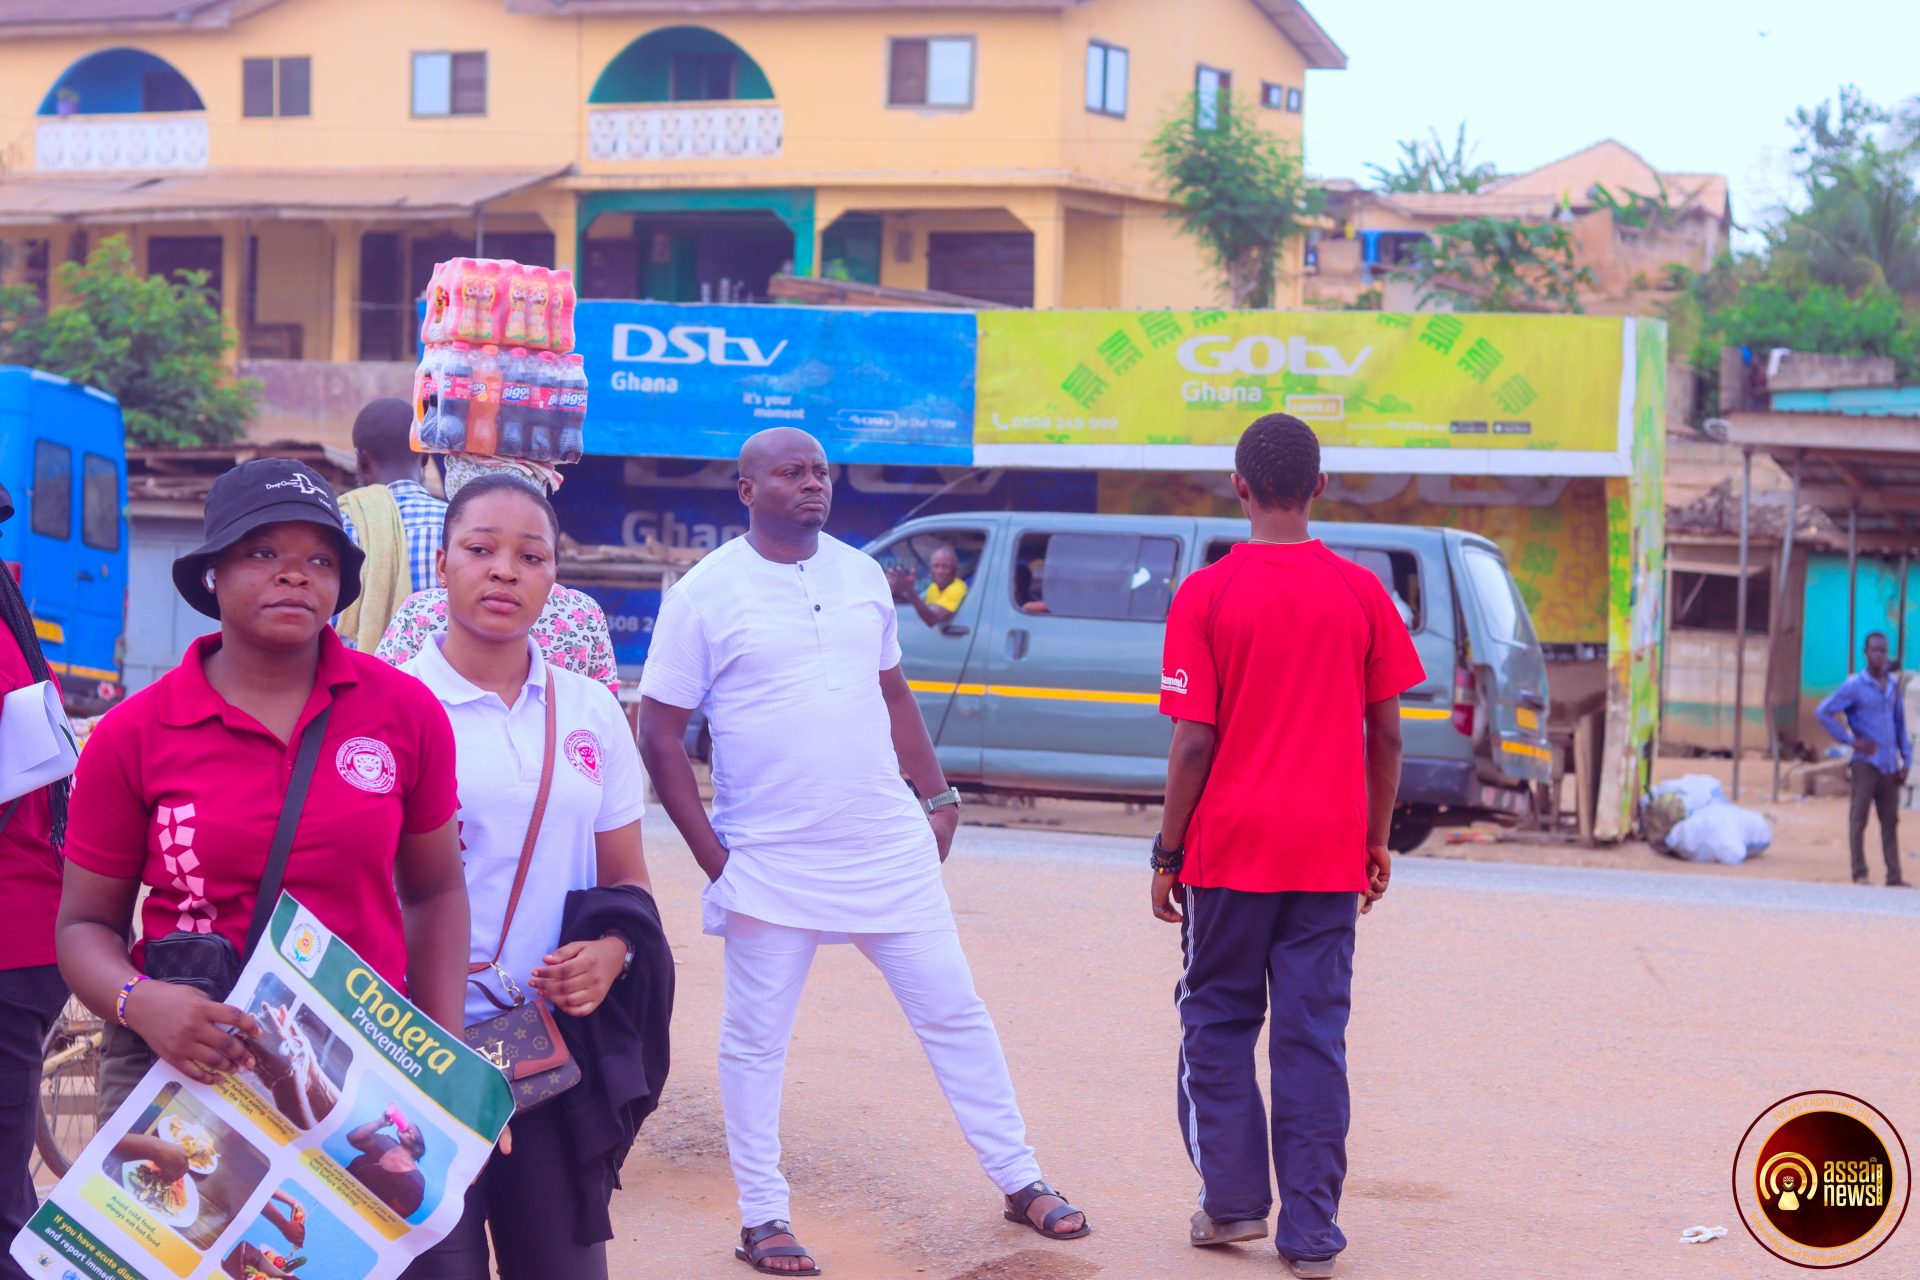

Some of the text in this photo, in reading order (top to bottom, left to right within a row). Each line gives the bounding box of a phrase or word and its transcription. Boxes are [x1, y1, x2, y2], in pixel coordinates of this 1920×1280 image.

[612, 323, 788, 367] DStv
[1176, 335, 1373, 376] GOtv
[611, 371, 679, 393] Ghana
[1182, 381, 1262, 403] Ghana
[754, 407, 805, 419] moment
[345, 967, 457, 1075] Cholera
[352, 1006, 423, 1078] Prevention
[44, 1226, 60, 1241] and
[59, 1238, 87, 1262] report
[53, 1214, 62, 1223] If
[60, 1221, 76, 1237] you
[76, 1232, 96, 1252] have
[95, 1250, 118, 1269] acute
[125, 1218, 135, 1228] eat
[135, 1224, 146, 1236] hot
[146, 1233, 161, 1247] food
